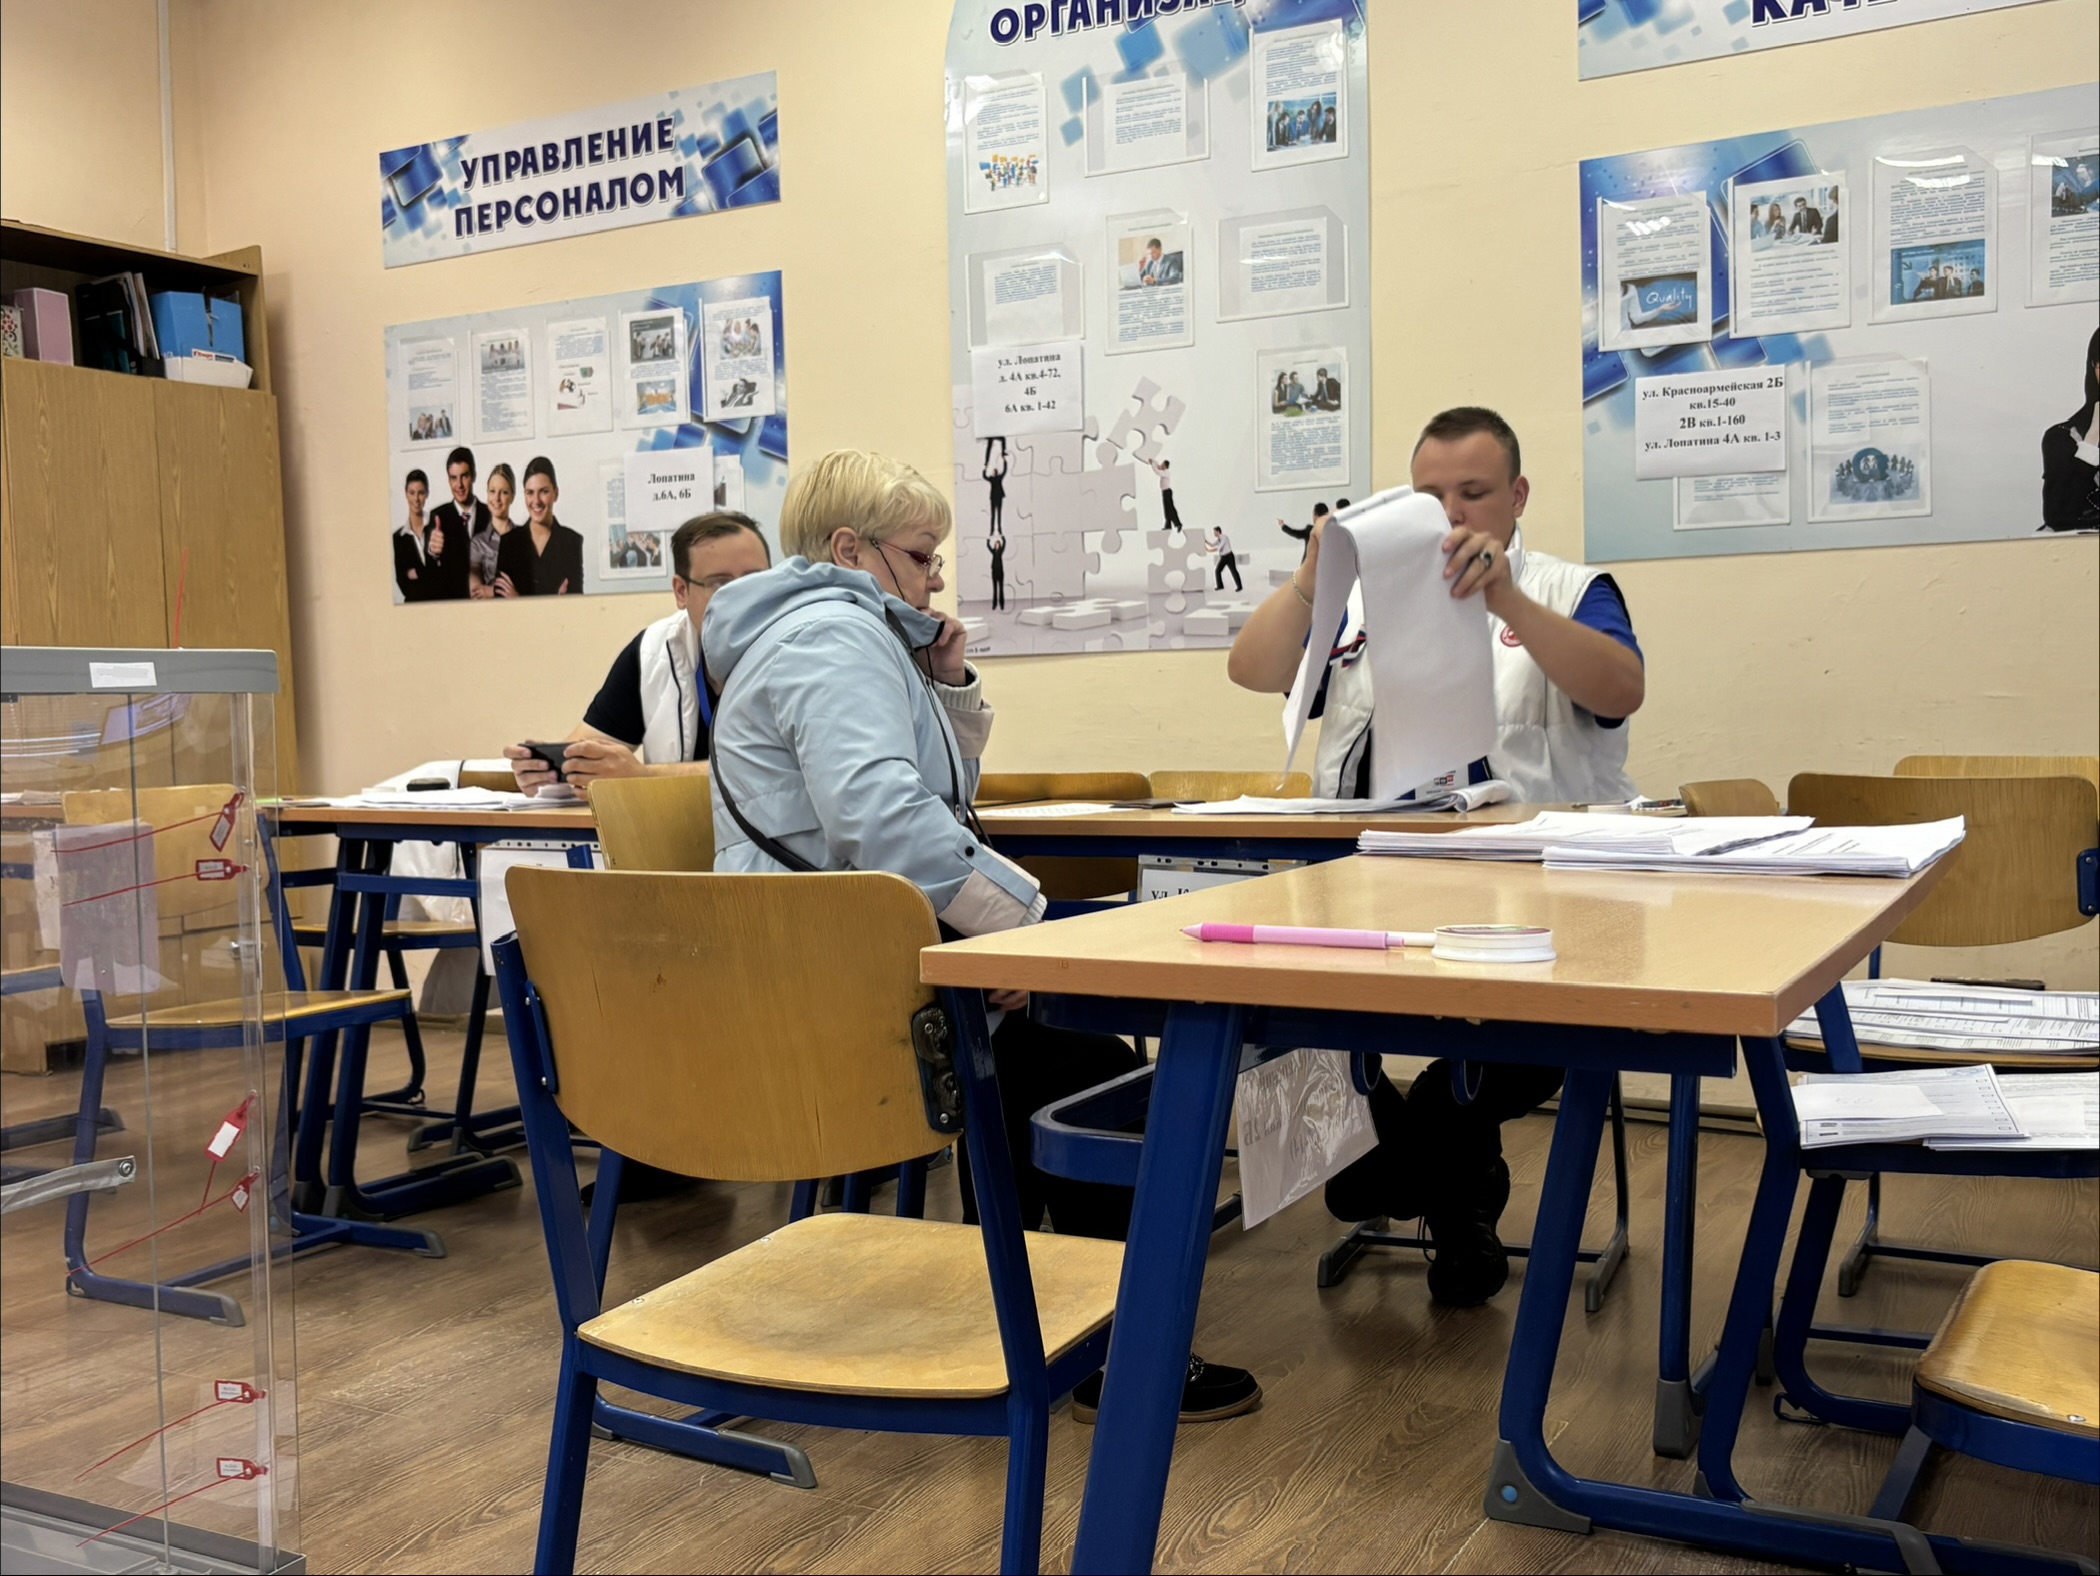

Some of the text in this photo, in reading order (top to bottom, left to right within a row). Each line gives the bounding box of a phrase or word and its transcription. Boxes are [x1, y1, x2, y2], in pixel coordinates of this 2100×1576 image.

[460, 116, 675, 189] УПРАВЛЕНИЕ
[454, 165, 686, 238] ПЕРСОНАЛОМ
[1646, 287, 1692, 310] Quality
[998, 353, 1061, 369] ул. Лопатина
[1009, 371, 1023, 382] 4А
[1024, 386, 1037, 396] 4Б
[1642, 377, 1784, 400] ул. Красноармейская 2Б
[1005, 400, 1056, 413] 6А кв. 1-42
[1689, 397, 1736, 410] кв.15-40
[1679, 414, 1746, 430] 2В кв.1-160
[1644, 431, 1781, 452] ул. Лопатина 4А кв. 1-3
[648, 473, 695, 484] Лопатина
[652, 488, 692, 501] д.6А, 6Б
